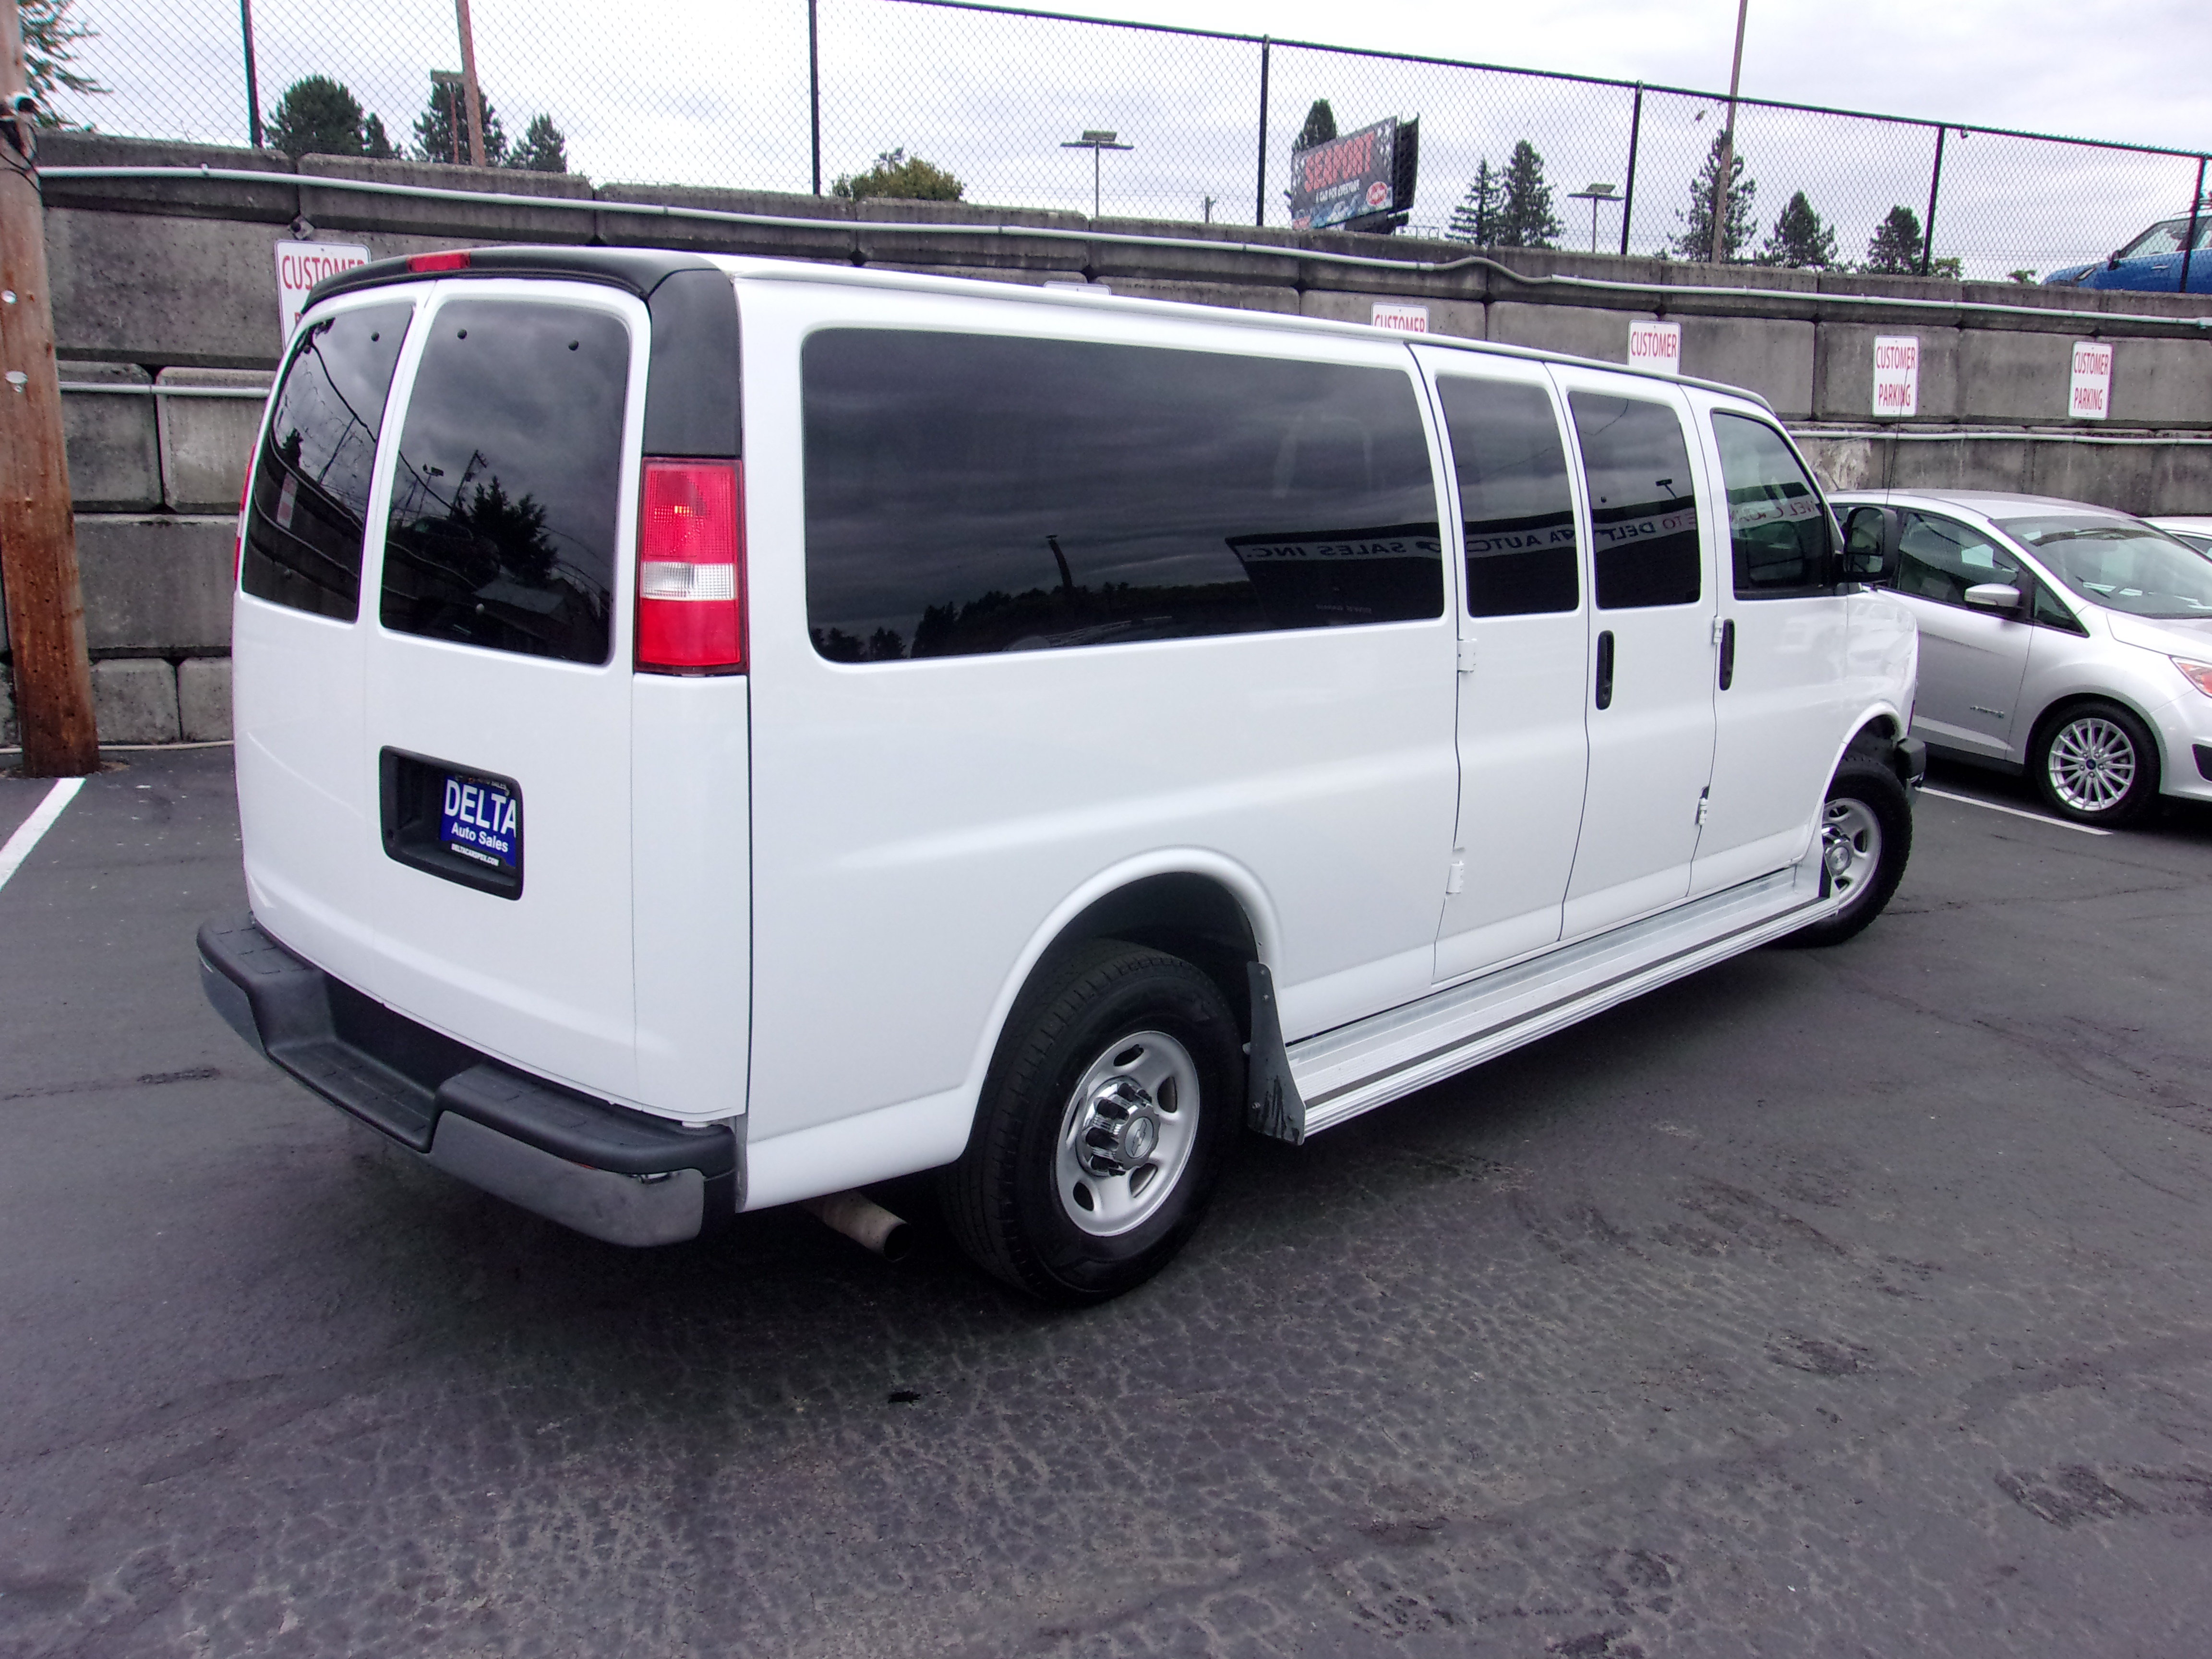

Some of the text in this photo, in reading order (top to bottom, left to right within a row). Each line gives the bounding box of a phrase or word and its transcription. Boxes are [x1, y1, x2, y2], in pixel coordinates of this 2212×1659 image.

[1305, 131, 1374, 192] SEAPORT
[282, 255, 365, 290] CUSTO
[1631, 331, 1677, 358] CUSTOMER
[1876, 345, 1916, 369] CUSTOMER
[2074, 351, 2109, 375] CUSTOMER
[1878, 383, 1911, 407] PARKING
[2074, 387, 2103, 410] PARKING
[444, 779, 516, 838] DELTA
[451, 822, 508, 853] Auto Sales
